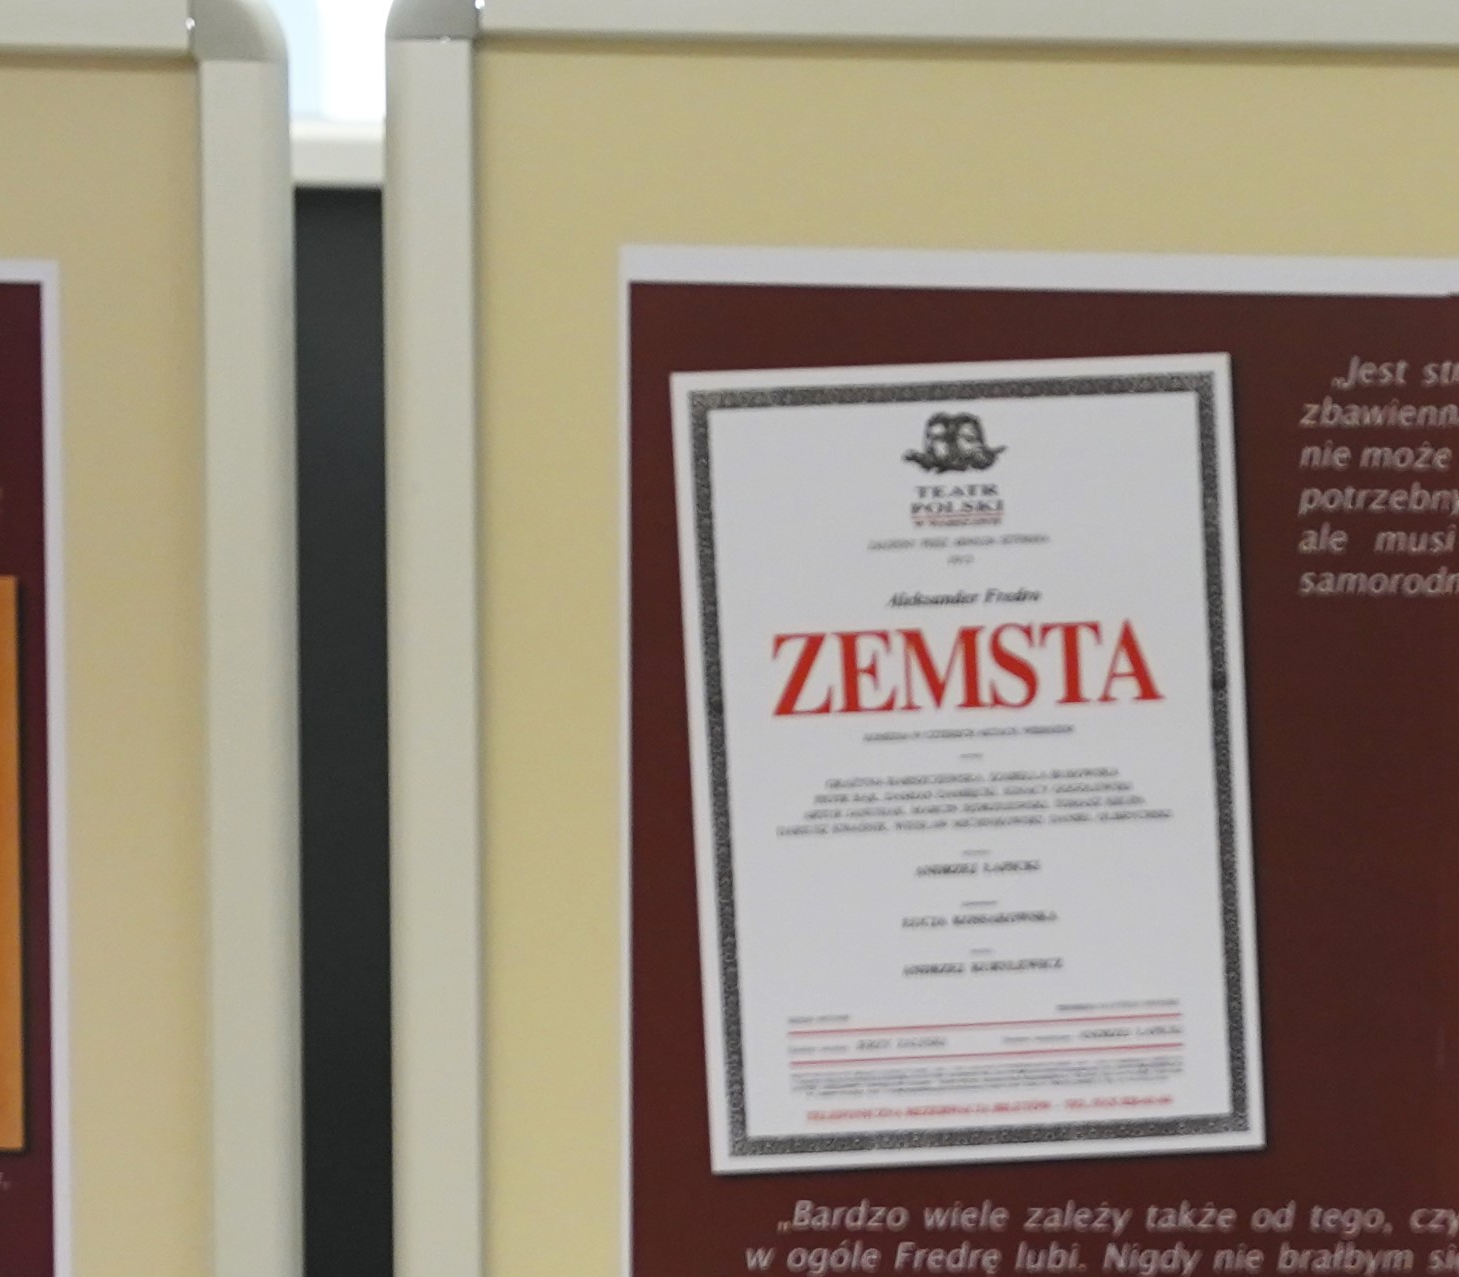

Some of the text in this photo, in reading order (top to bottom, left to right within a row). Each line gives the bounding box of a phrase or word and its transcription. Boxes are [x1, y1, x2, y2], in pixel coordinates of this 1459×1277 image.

[1332, 356, 1408, 389] „Jest
[1300, 440, 1351, 469] nie
[1360, 441, 1452, 470] może
[918, 484, 998, 499] TEATR
[1299, 523, 1348, 553] ale
[1375, 524, 1456, 554] musi
[772, 619, 1164, 716] ZEMSTA
[778, 1200, 908, 1231] „Bardzo
[924, 1200, 1008, 1230] wiele
[1024, 1200, 1130, 1235] zależy
[1146, 1201, 1236, 1231] także
[1251, 1201, 1296, 1231] od
[1310, 1206, 1392, 1237] tego,
[746, 1248, 773, 1269] w
[787, 1240, 880, 1276] ogóle
[895, 1242, 1001, 1274] Fredrę
[1015, 1242, 1085, 1272] lubi.
[1103, 1242, 1200, 1277] Nigdy
[1213, 1249, 1264, 1272] nie
[1278, 1242, 1414, 1277] brałbym
